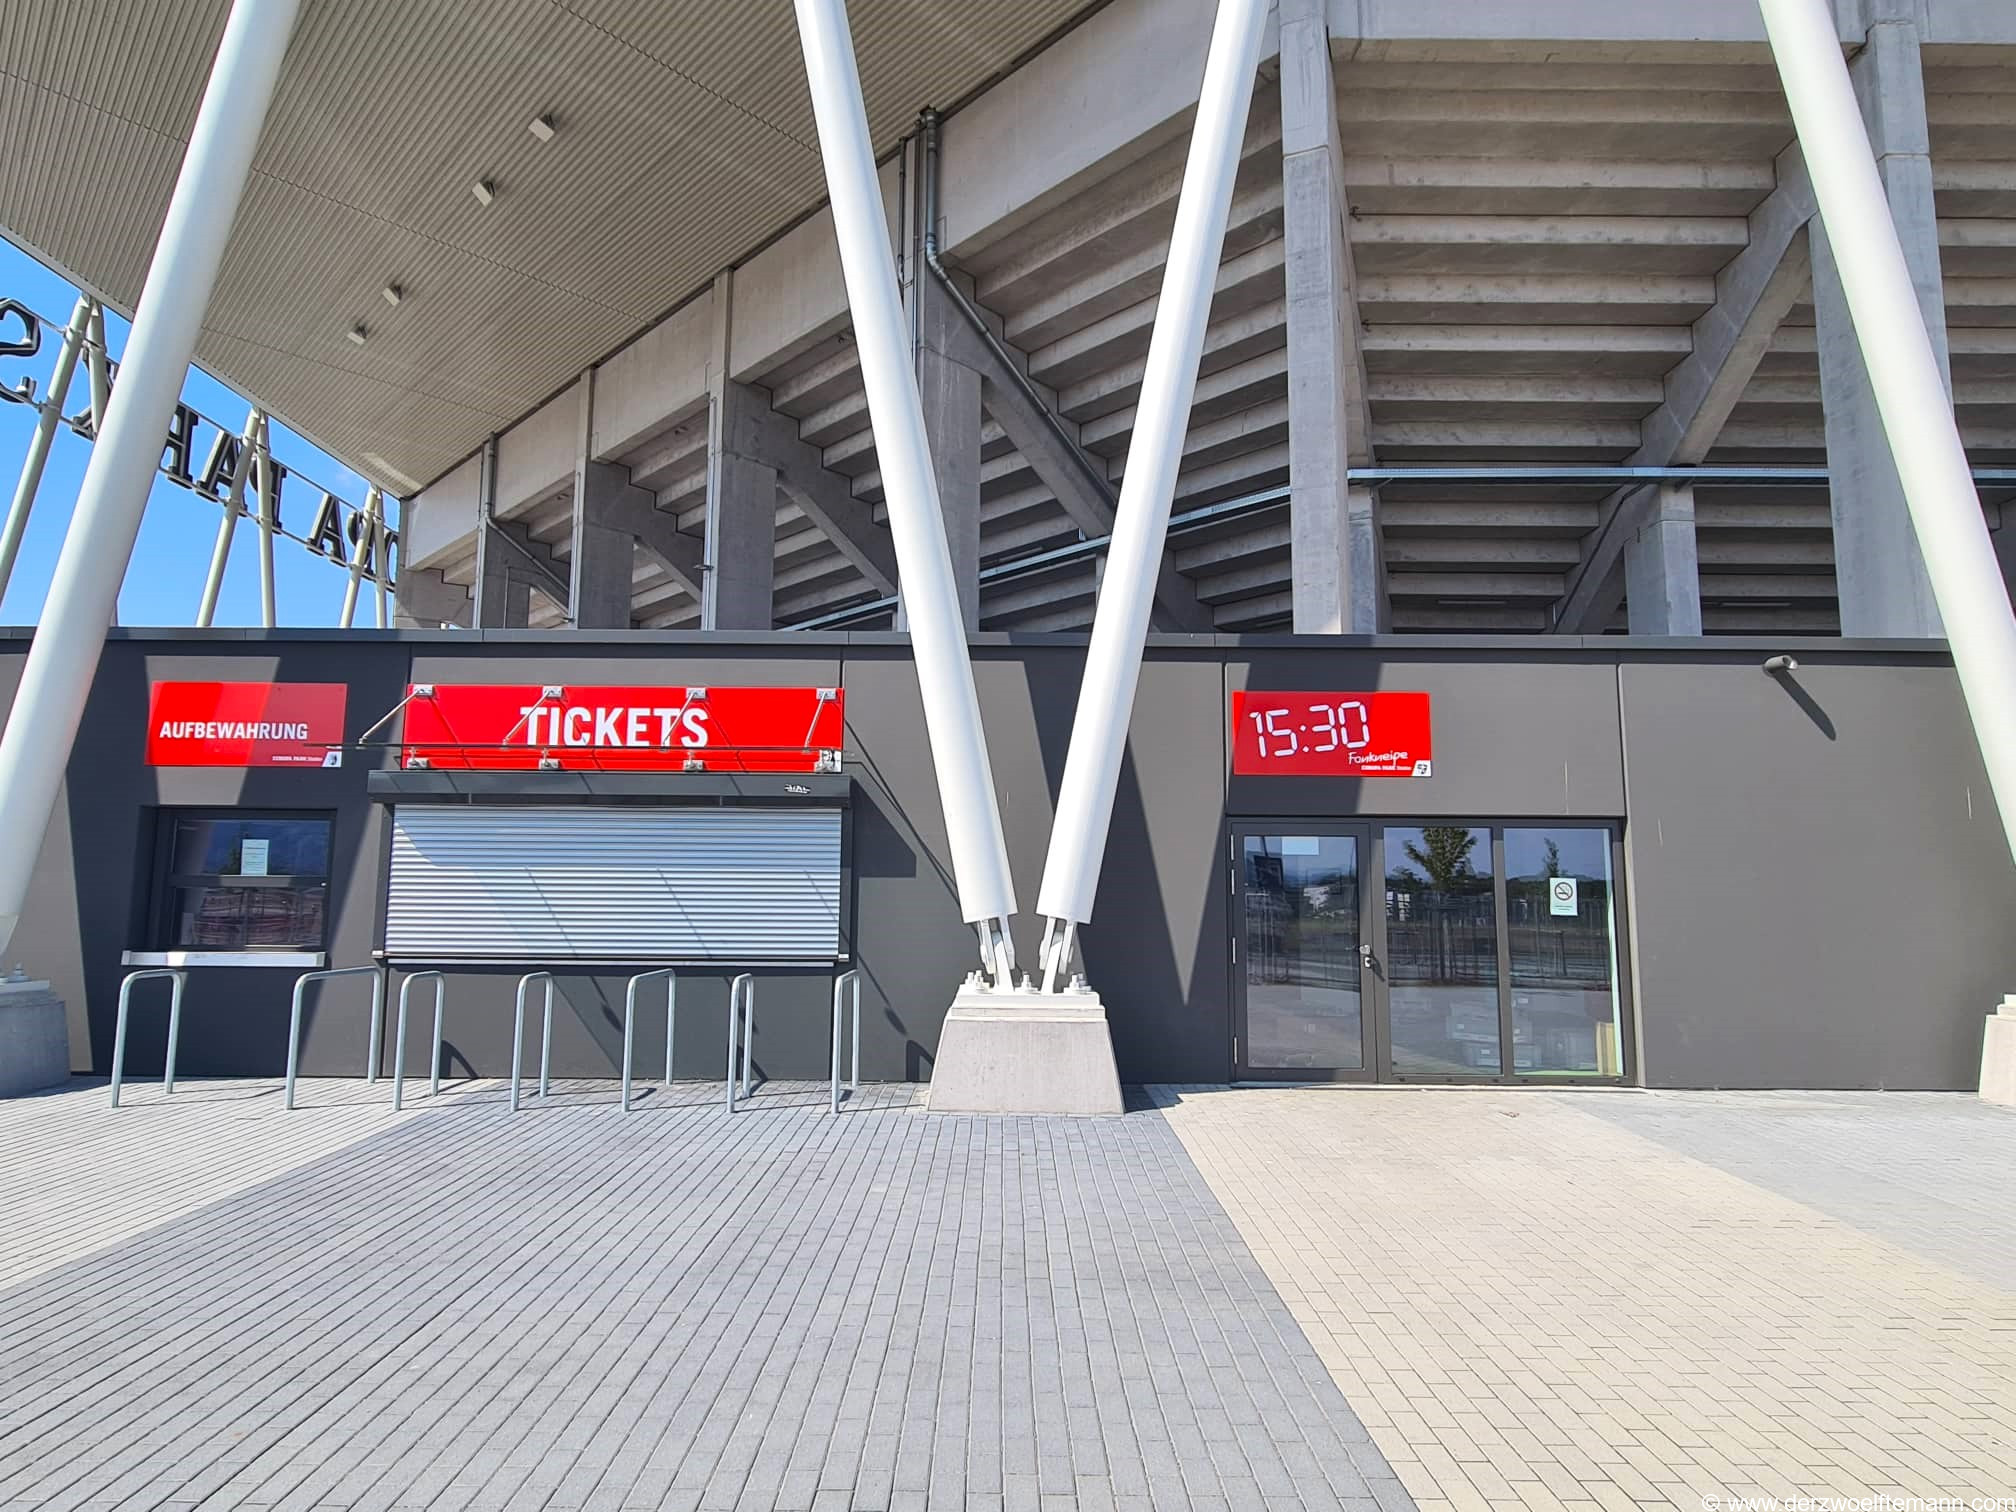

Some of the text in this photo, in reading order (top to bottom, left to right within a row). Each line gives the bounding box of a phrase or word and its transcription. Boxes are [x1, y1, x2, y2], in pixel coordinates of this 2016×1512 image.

[159, 721, 308, 740] AUFBEWAHRUNG
[520, 706, 708, 748] TICKETS
[1249, 701, 1370, 758] 15:30
[1348, 750, 1408, 767] Fankneipe
